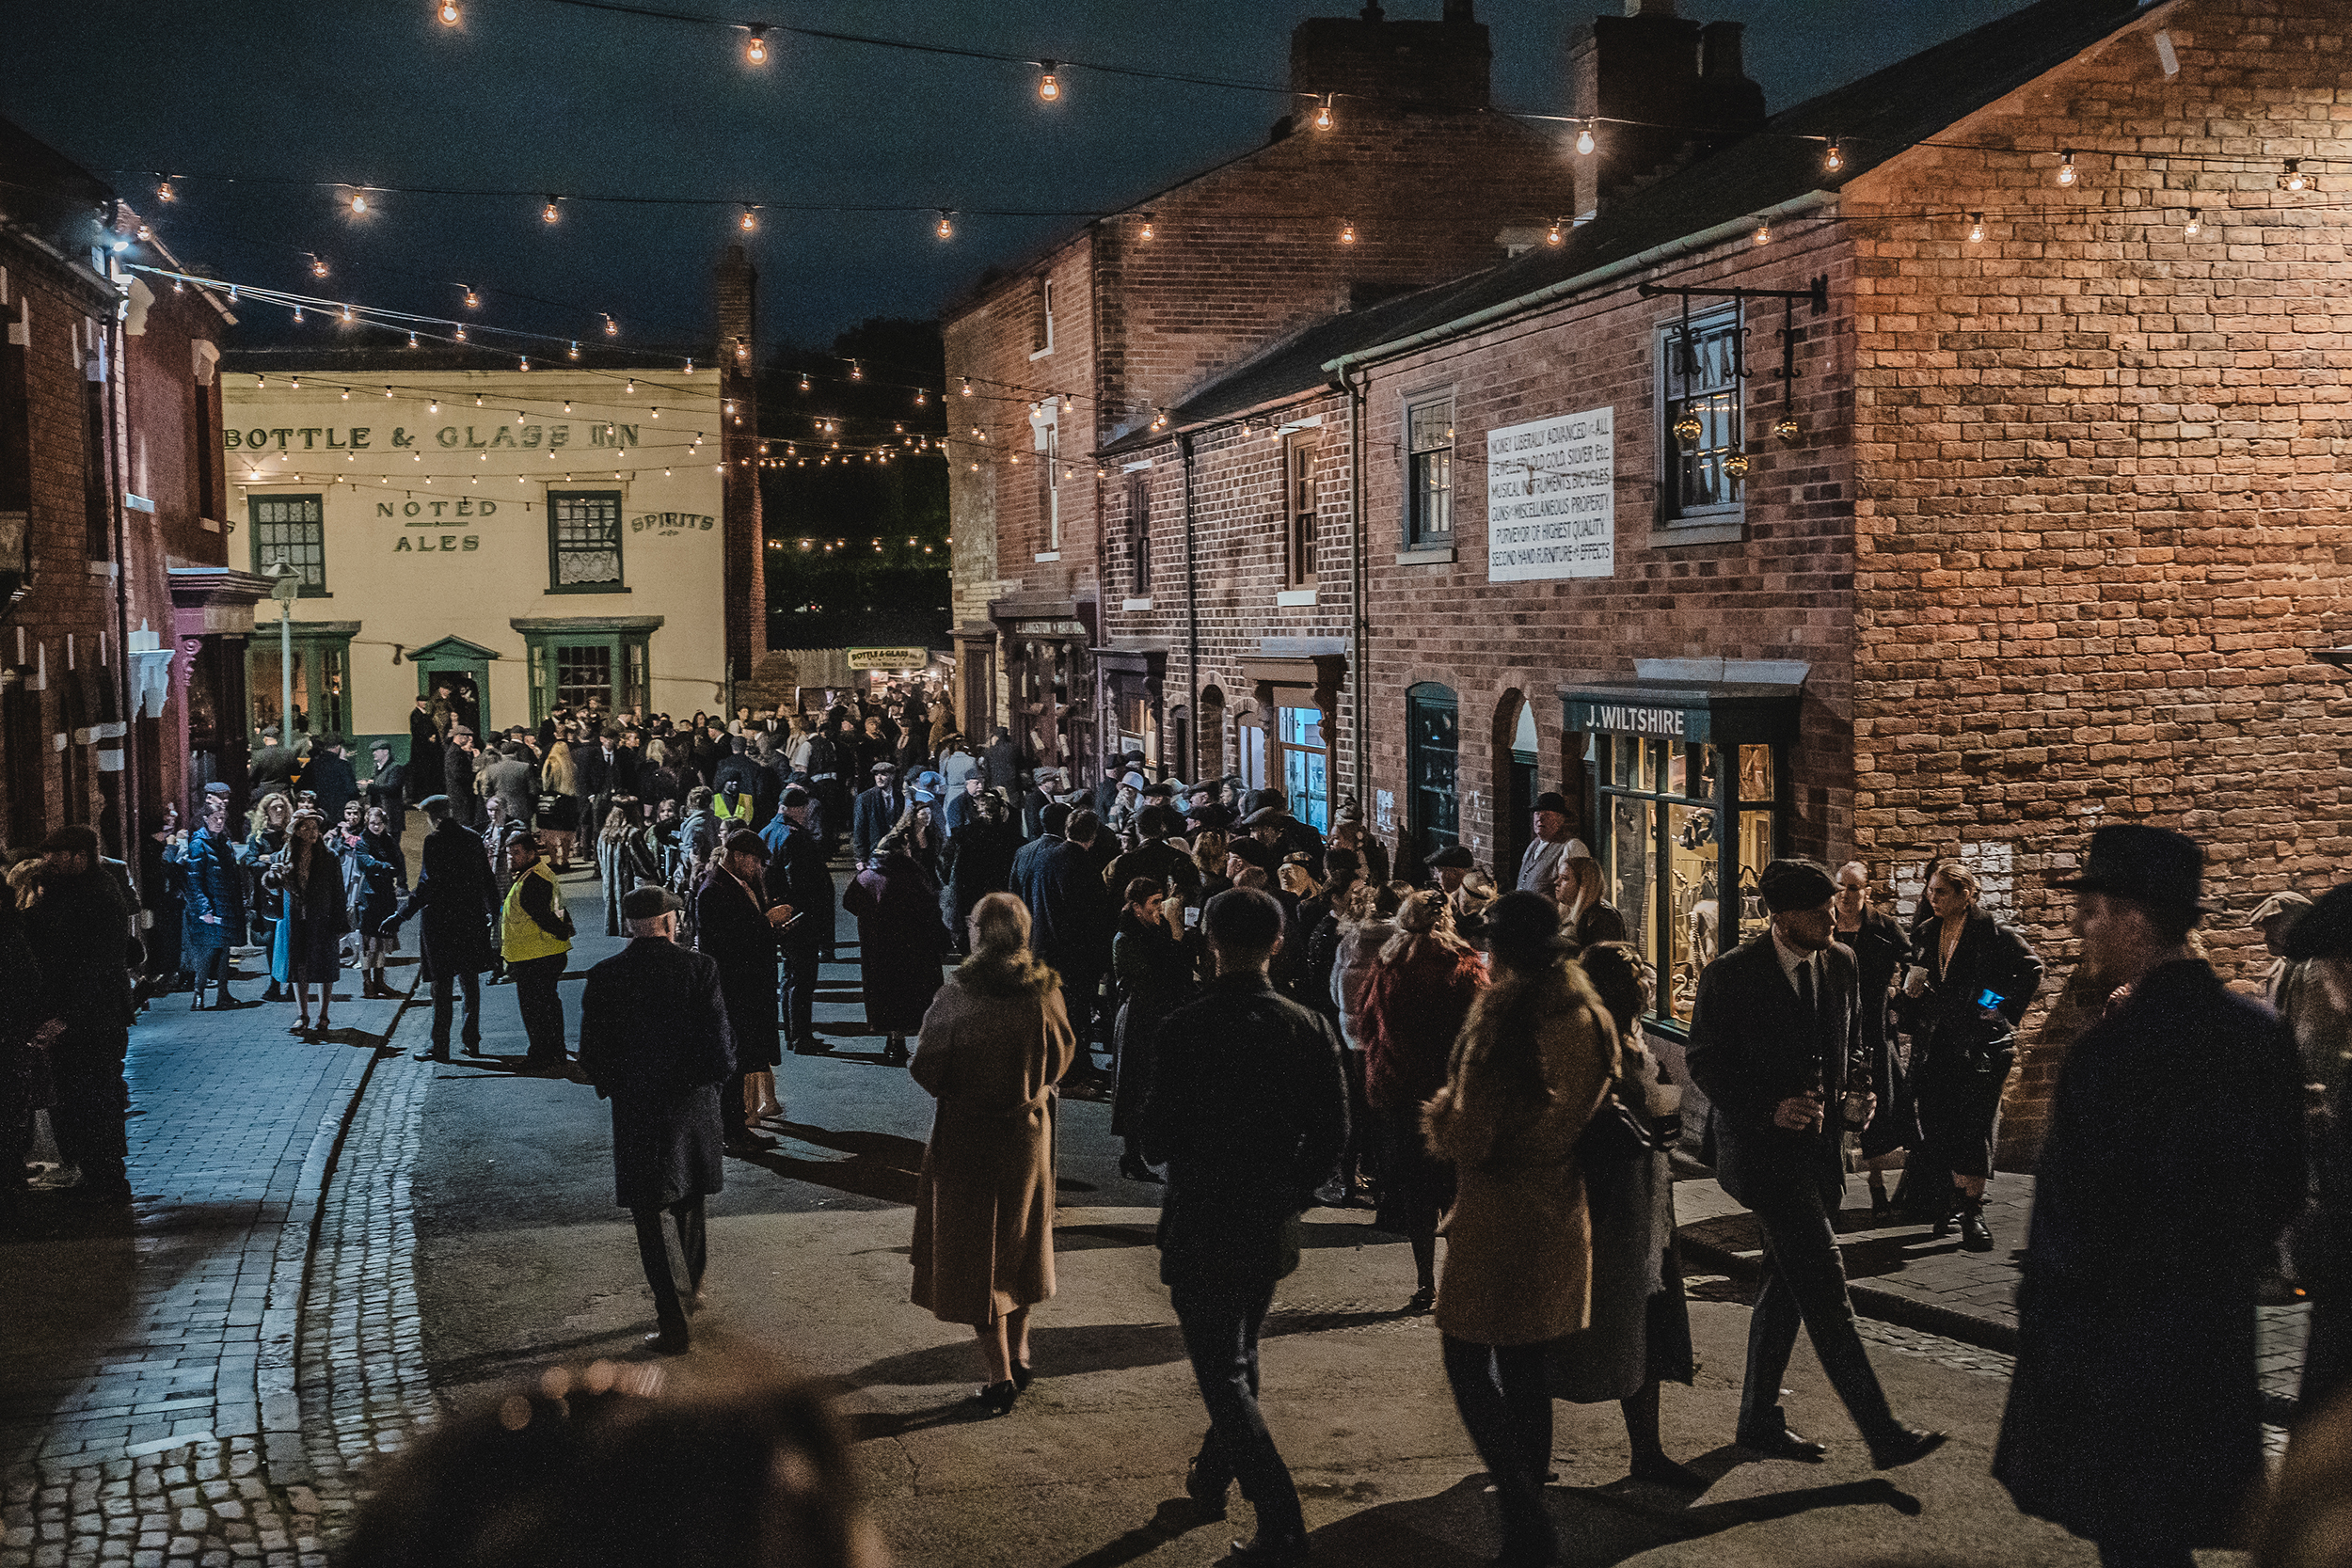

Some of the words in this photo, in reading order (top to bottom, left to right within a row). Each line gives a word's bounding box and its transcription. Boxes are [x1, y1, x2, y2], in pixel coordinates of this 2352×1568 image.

[224, 427, 371, 450] BOTTLE
[390, 427, 416, 449] &
[436, 425, 570, 449] GLASS
[590, 424, 640, 447] INN
[1515, 430, 1546, 451] LIBERALLY
[1547, 422, 1586, 446] ADVANCED
[1595, 417, 1610, 436] ALL
[1567, 445, 1593, 466] SILVER
[1491, 482, 1520, 499] MUSICAL
[1572, 467, 1610, 489] BICYCLES
[376, 500, 497, 518] NOTED
[1491, 505, 1509, 522] GUNS
[1514, 498, 1569, 519] MISCELLANEOUS
[1571, 493, 1610, 514] PROPERTY
[630, 512, 715, 533] SPIRITS
[1496, 526, 1530, 545] PURVEYOR
[1531, 524, 1540, 542] OF
[1543, 521, 1571, 540] HIGHEST
[1572, 517, 1605, 541] QUALITY
[393, 534, 480, 553] ALES
[1491, 549, 1516, 566] SECOND
[1517, 547, 1534, 565] HAND
[1536, 545, 1572, 563] FURNITURE
[1581, 542, 1610, 561] EFFECTS
[851, 651, 878, 661] BOTTLE
